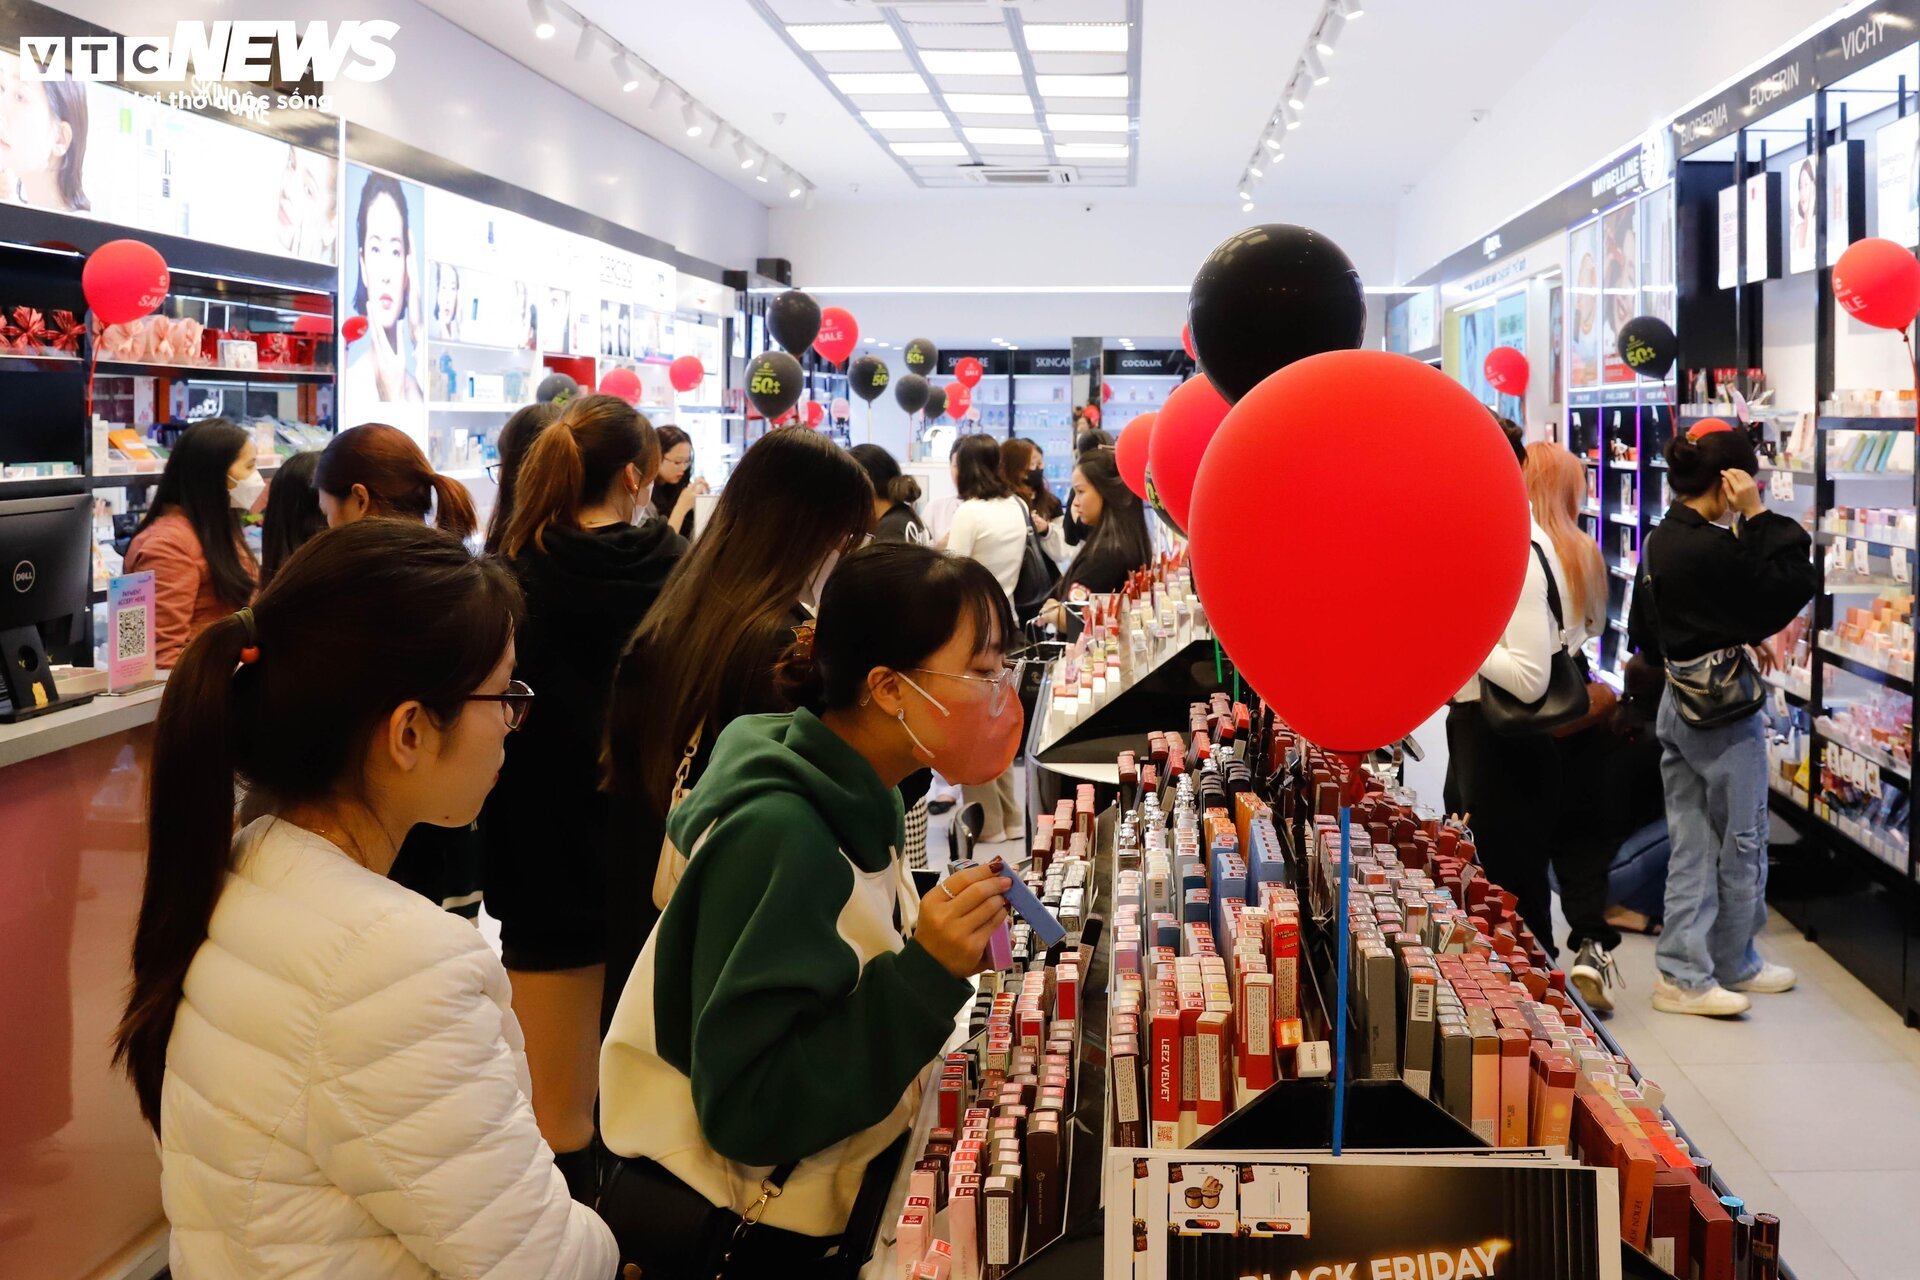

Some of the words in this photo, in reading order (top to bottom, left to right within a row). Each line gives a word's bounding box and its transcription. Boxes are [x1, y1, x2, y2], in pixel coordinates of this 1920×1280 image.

[1841, 20, 1887, 60] VICHY
[1749, 62, 1800, 109] EUCERIN
[818, 331, 843, 343] SALE
[1121, 359, 1162, 368] COCOLUX
[1160, 1038, 1171, 1063] LEEZ
[1160, 1064, 1171, 1102] VELVET
